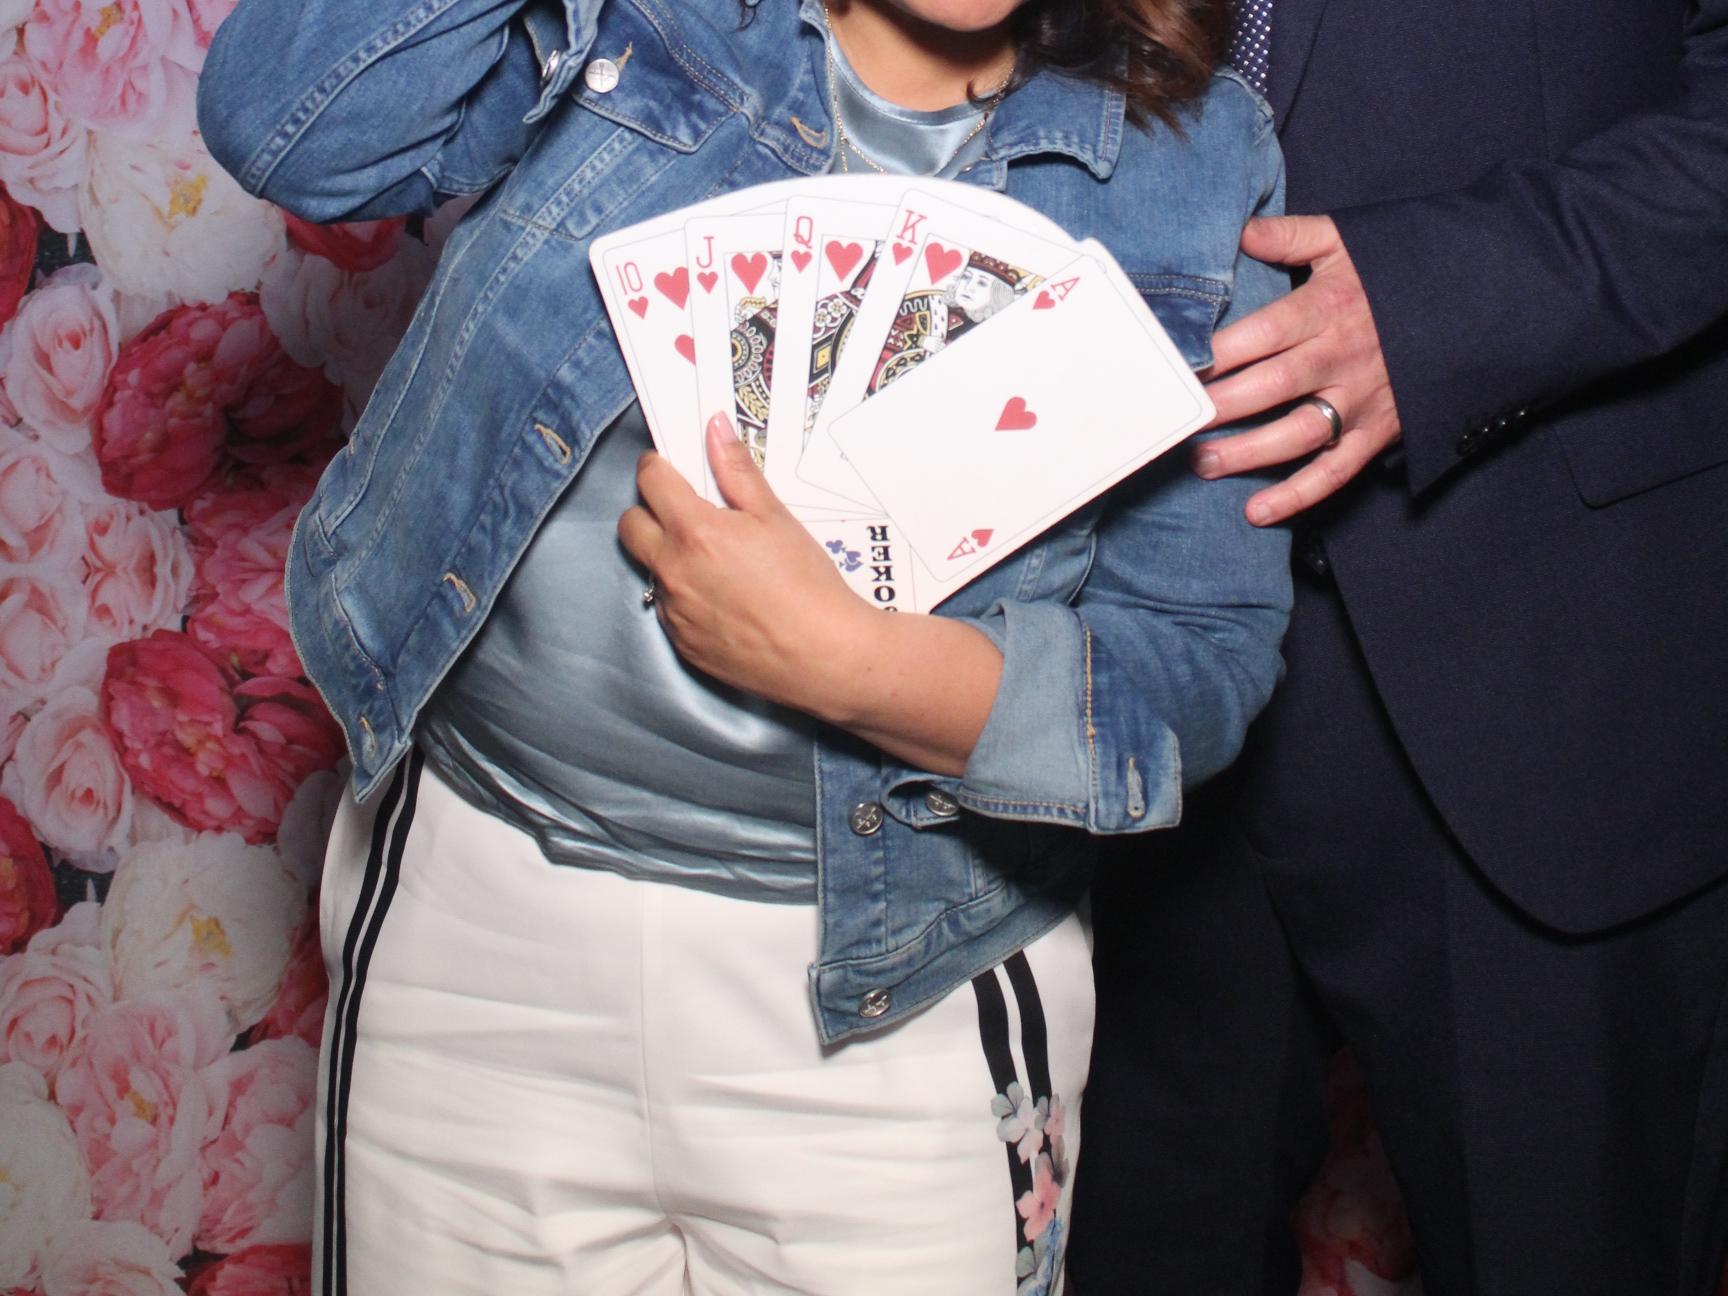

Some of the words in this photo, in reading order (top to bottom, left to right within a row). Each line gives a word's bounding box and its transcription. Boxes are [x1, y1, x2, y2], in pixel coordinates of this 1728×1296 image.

[793, 215, 814, 249] Q
[896, 209, 928, 245] K
[696, 236, 715, 269] J
[614, 261, 645, 296] 10
[1051, 277, 1081, 301] A
[947, 537, 977, 561] A
